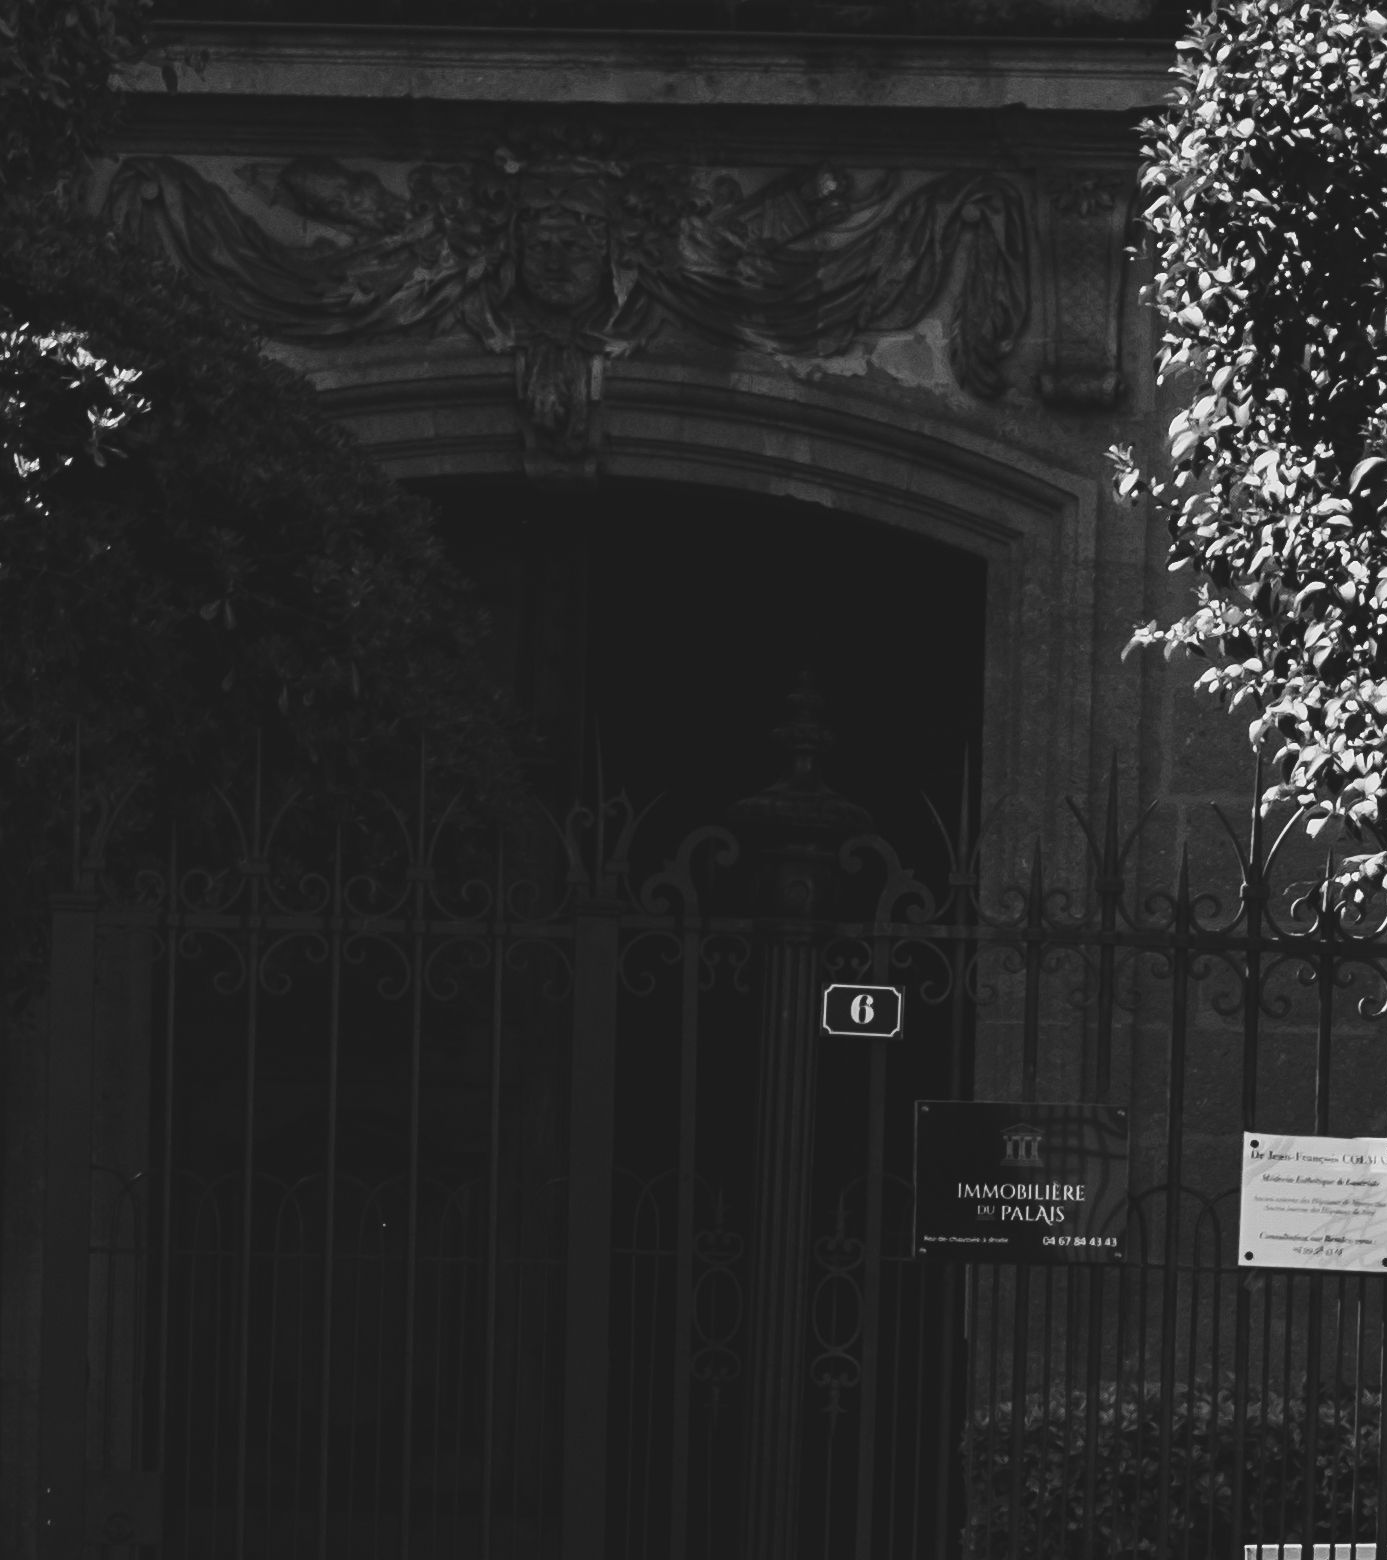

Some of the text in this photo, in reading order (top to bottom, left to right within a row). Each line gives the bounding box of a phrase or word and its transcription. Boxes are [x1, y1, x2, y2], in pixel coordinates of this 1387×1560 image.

[850, 994, 875, 1025] 6
[1250, 1150, 1265, 1160] Dr
[957, 1182, 1086, 1202] IMMOBILIÈRE
[976, 1205, 1066, 1227] DU PALAIS
[1042, 1236, 1118, 1247] 04 67 84 43 43
